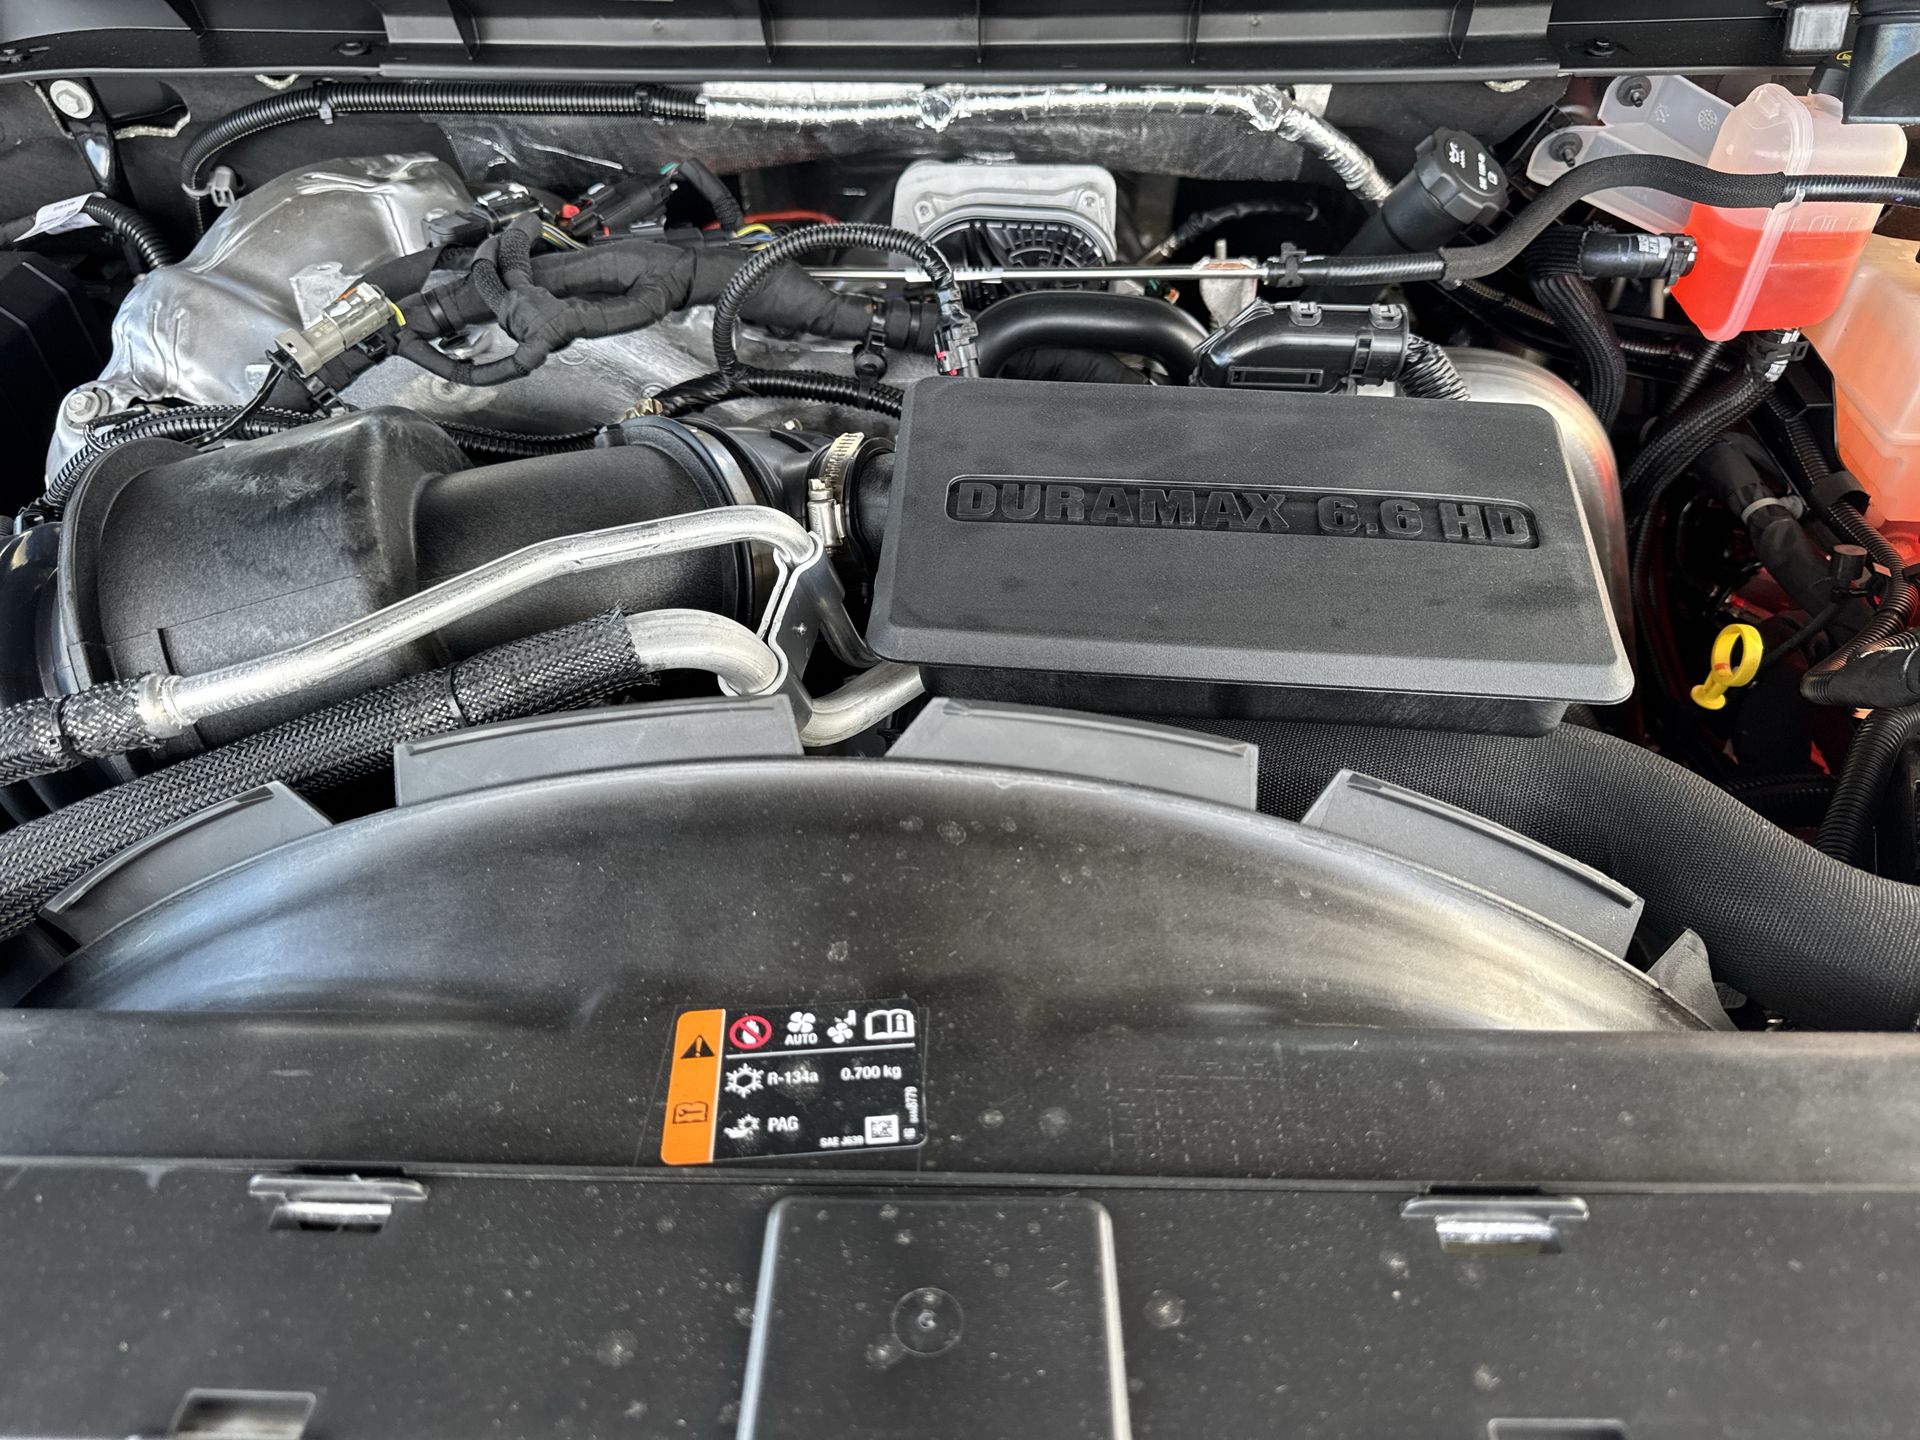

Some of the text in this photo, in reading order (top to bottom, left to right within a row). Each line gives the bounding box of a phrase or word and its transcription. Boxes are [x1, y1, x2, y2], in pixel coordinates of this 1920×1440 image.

[956, 482, 1532, 543] DURAMAX 6.6 HD
[784, 1032, 818, 1046] AUTO
[766, 1064, 903, 1086] R-134a 0.700 kg
[767, 1115, 800, 1133] PAG
[819, 1136, 840, 1149] SAE
